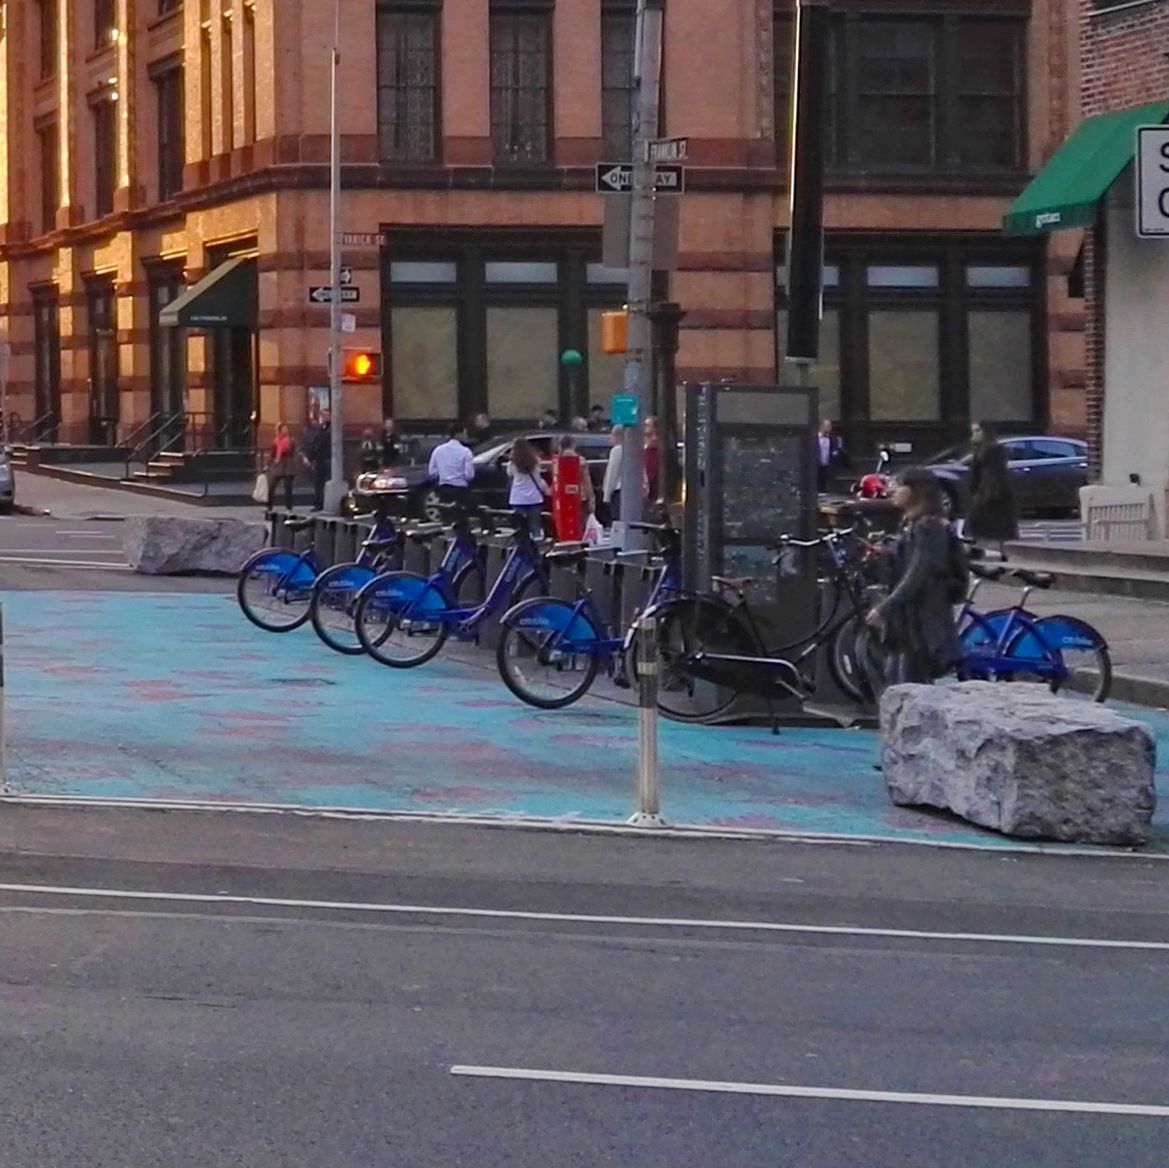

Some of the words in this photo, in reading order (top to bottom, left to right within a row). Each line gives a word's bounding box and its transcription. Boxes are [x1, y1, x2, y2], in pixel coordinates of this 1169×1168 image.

[650, 141, 677, 161] FRANKLIN
[611, 173, 633, 184] ONE
[656, 173, 671, 184] AY
[345, 234, 372, 245] VARICK
